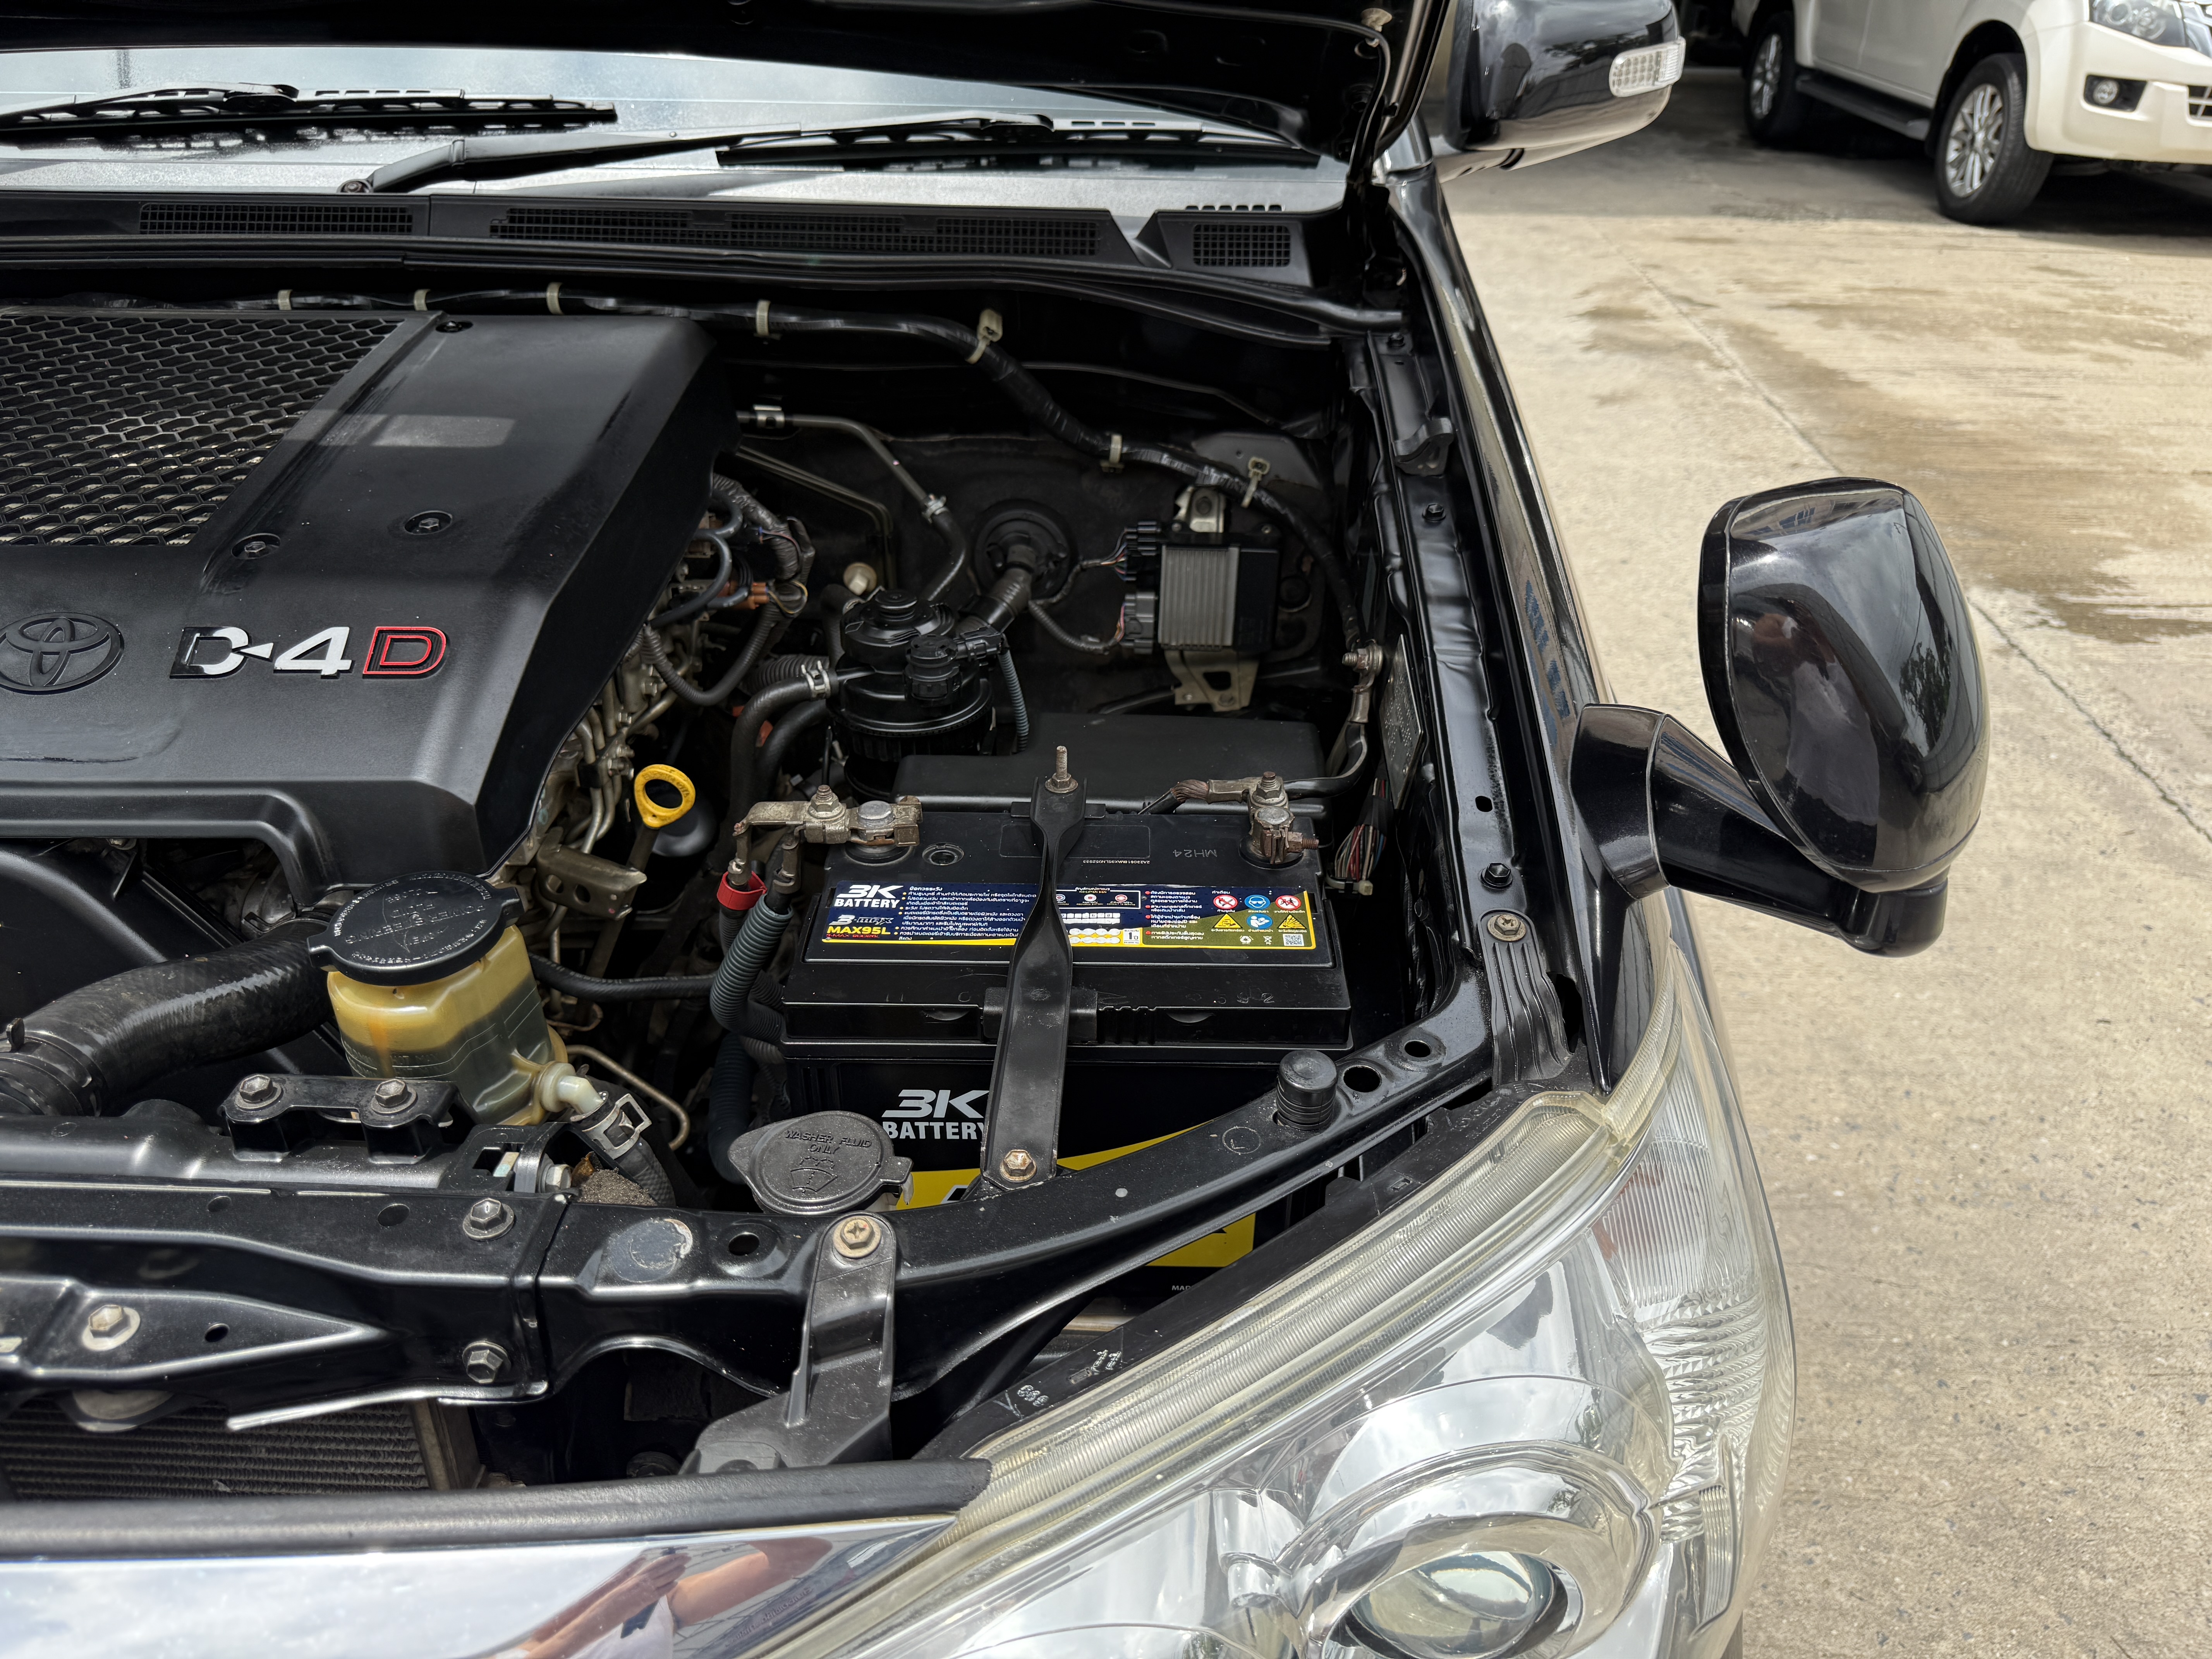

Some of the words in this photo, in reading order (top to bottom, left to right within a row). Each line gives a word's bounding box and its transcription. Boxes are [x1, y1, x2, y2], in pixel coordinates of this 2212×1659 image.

[1173, 849, 1218, 858] MH24
[836, 885, 904, 898] 3K
[390, 902, 436, 918] FLUID
[834, 898, 900, 908] BATTERY
[430, 905, 486, 922] POWER
[345, 915, 425, 944] STEERING
[827, 926, 891, 934] MAX95L
[881, 1089, 989, 1118] 3K
[785, 1129, 834, 1144] WASHER
[841, 1137, 872, 1148] FLUID
[808, 1143, 840, 1154] ONLY
